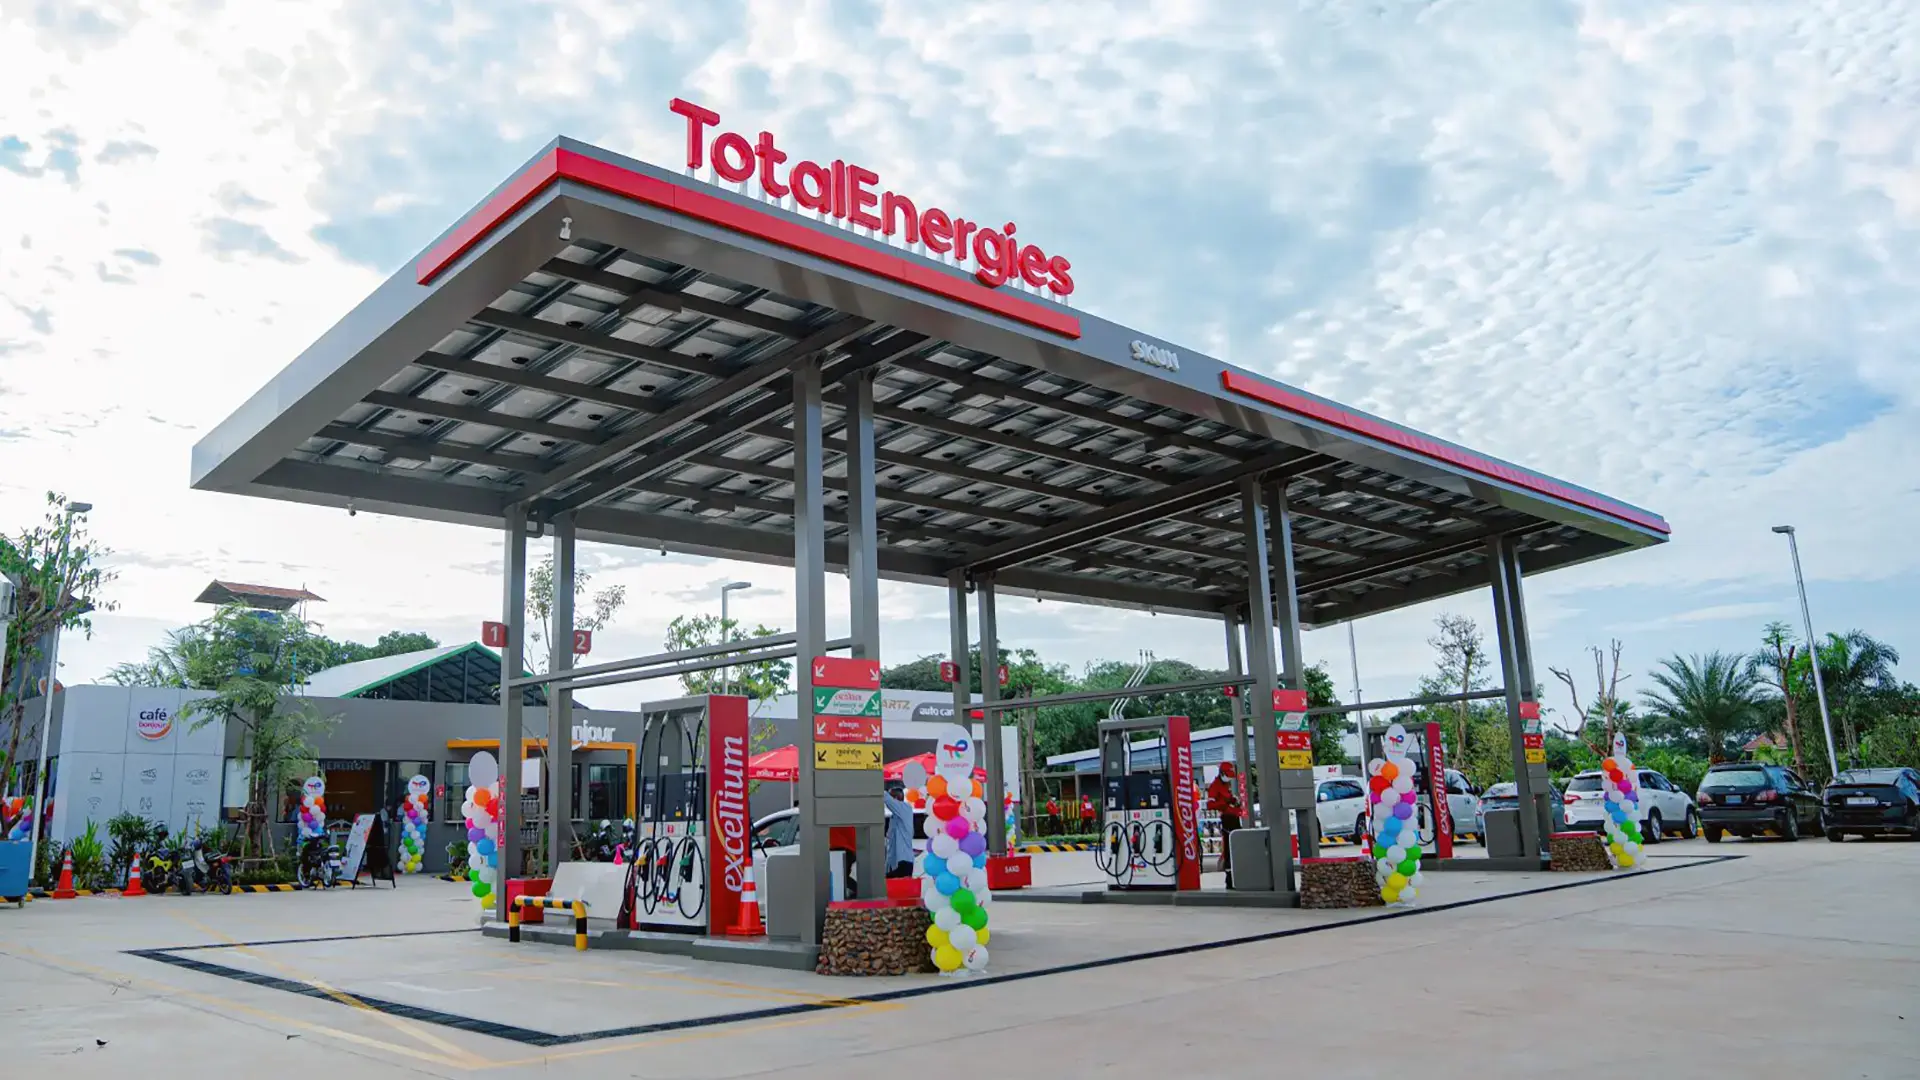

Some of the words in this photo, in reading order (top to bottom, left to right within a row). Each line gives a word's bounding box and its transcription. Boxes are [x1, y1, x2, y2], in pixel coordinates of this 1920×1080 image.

[669, 97, 1076, 295] TotalEnergies
[1130, 339, 1180, 372] SKUN
[490, 626, 498, 643] 1
[576, 634, 586, 650] 2
[945, 664, 954, 678] 3
[140, 708, 167, 721] café
[882, 700, 911, 710] ARTZ
[919, 706, 939, 716] auto
[940, 708, 954, 717] car
[572, 719, 617, 746] njour
[1433, 746, 1449, 835] excellium
[719, 736, 744, 892] excellium
[1177, 746, 1196, 861] excellium
